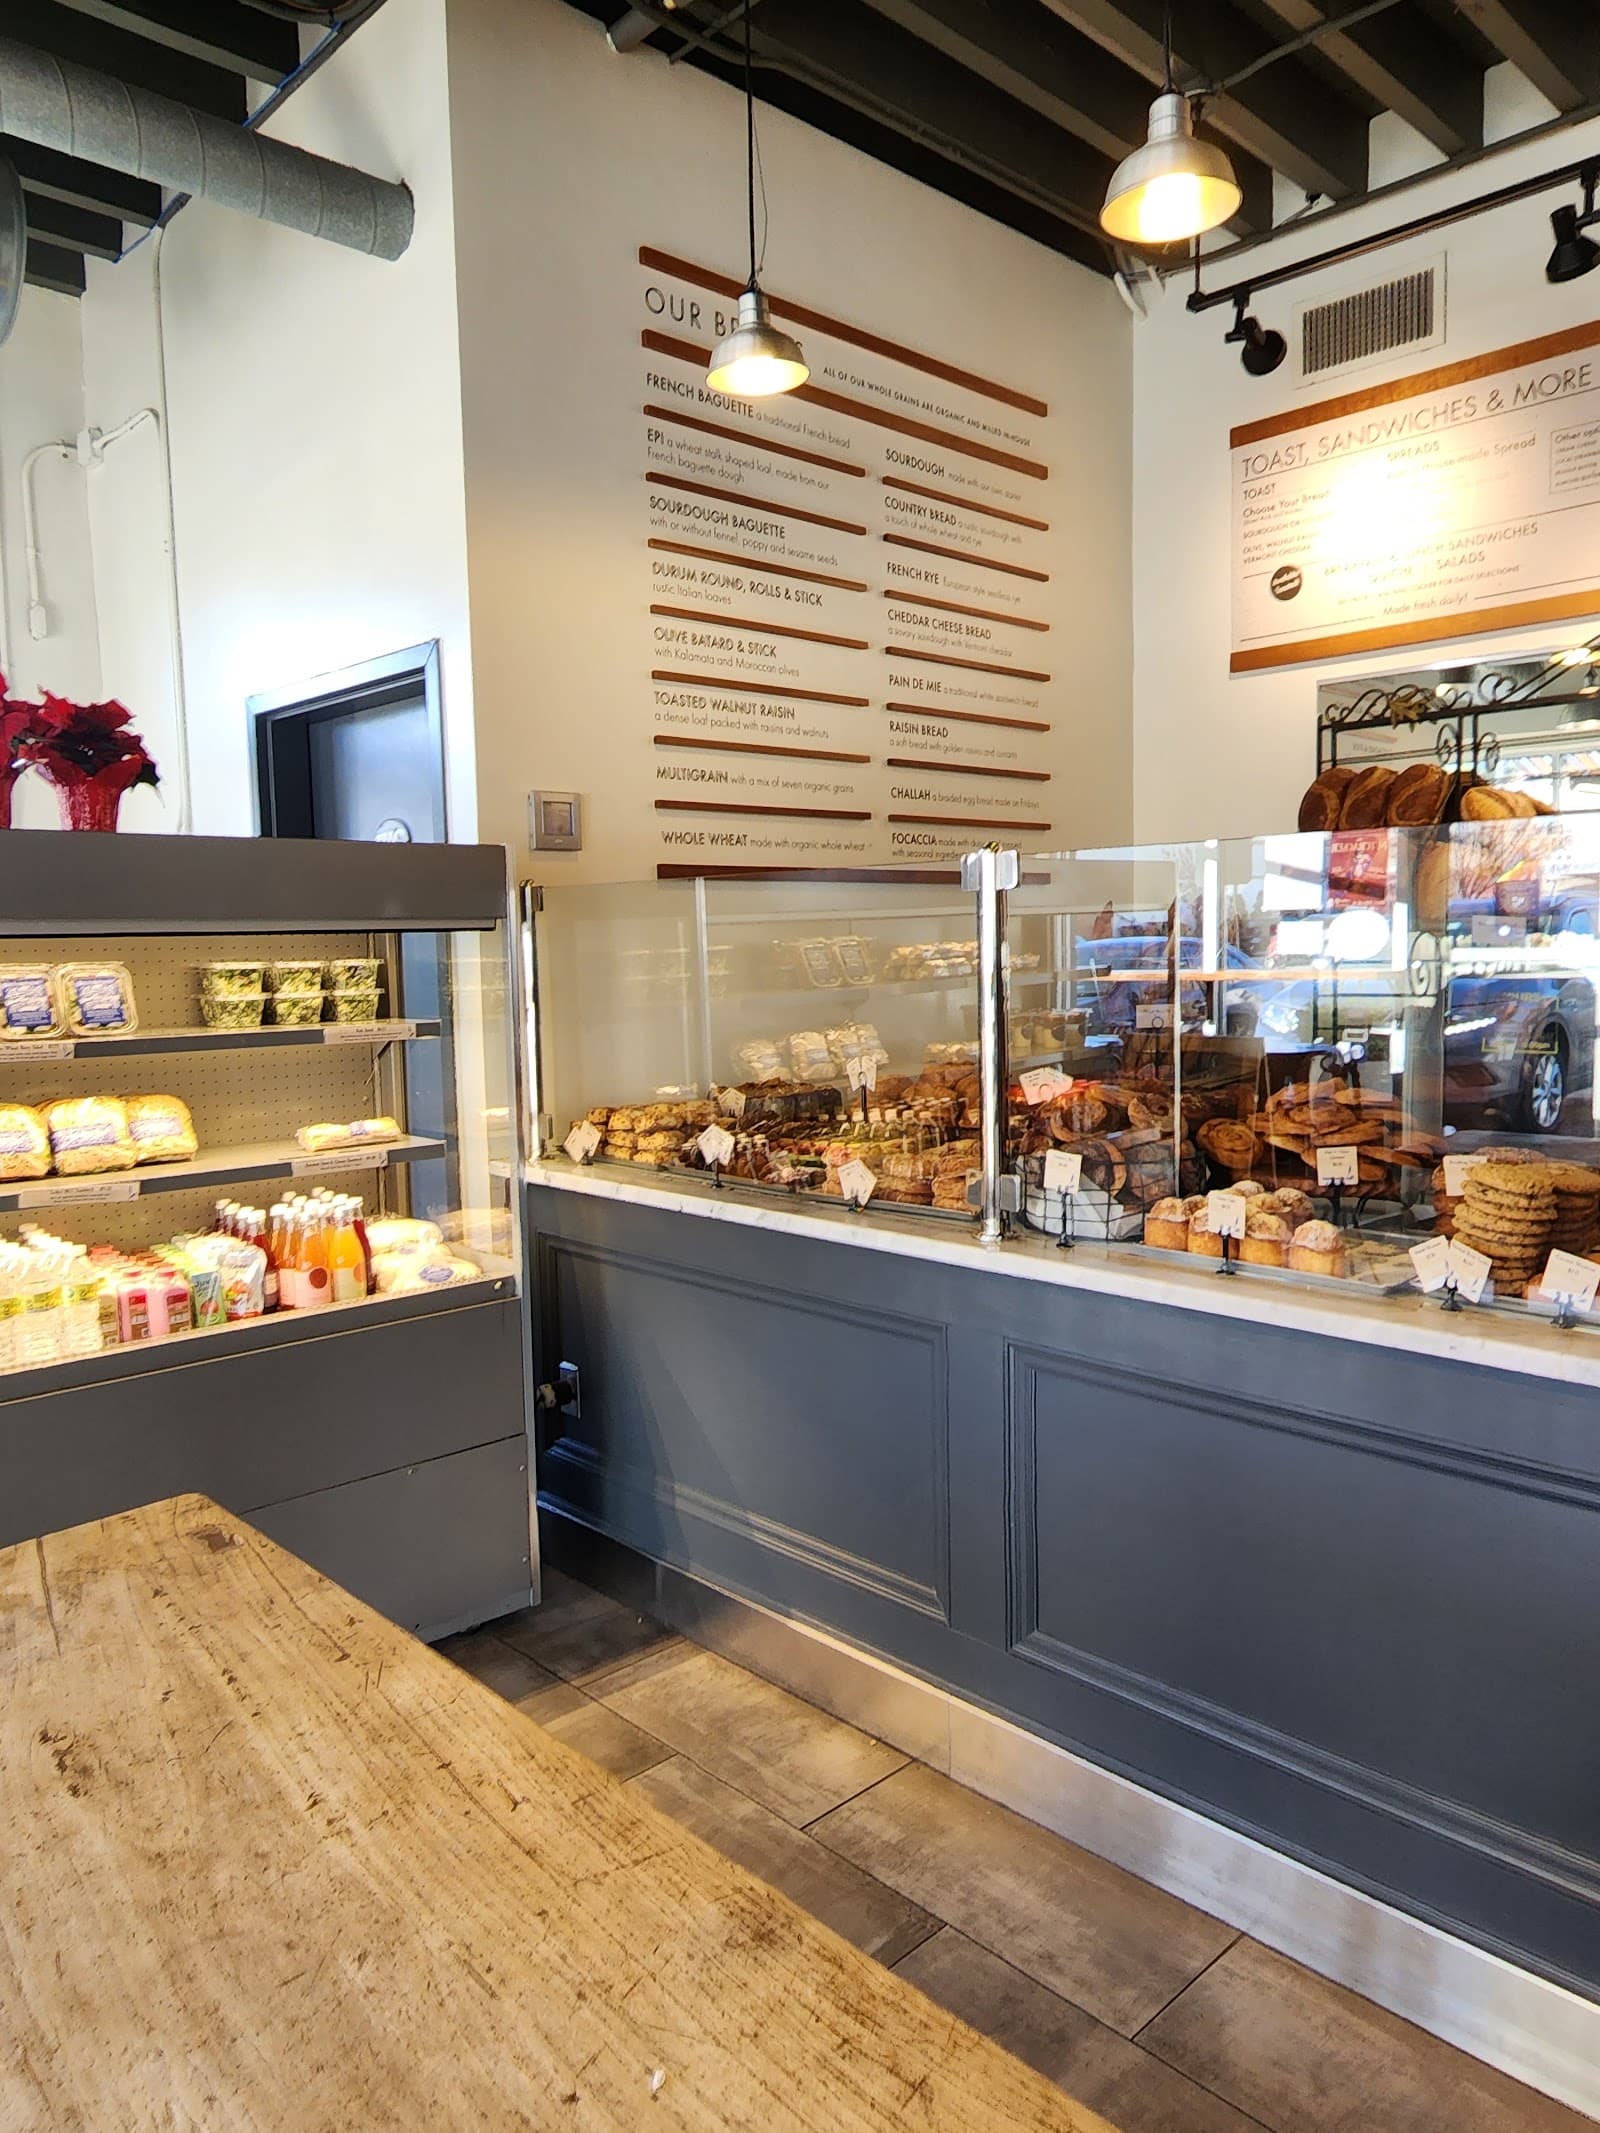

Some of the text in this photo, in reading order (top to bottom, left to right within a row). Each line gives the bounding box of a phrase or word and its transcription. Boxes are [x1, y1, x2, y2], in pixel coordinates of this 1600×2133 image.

[644, 287, 701, 330] OUR
[646, 372, 694, 400] FRENCH
[698, 388, 754, 418] BAGUETTE
[763, 412, 801, 432] traditional
[803, 423, 825, 440] French
[828, 434, 850, 448] bread
[823, 366, 835, 378] ALL
[838, 371, 848, 381] OF
[850, 375, 865, 388] OUR
[867, 382, 892, 398] WHOLE
[894, 391, 919, 407] GRAINS
[921, 401, 933, 412] ARE
[935, 406, 965, 424] ORGANIC
[967, 418, 981, 428] AND
[1241, 362, 1592, 479] TOAST, SANDWICHES & MORE
[647, 428, 664, 444] EPI
[675, 440, 702, 455] wheat
[704, 449, 721, 460] stalk
[725, 453, 755, 469] shaped
[775, 468, 796, 482] made
[799, 473, 815, 485] from
[817, 480, 830, 489] our
[1494, 434, 1536, 457] Spread
[648, 446, 745, 484] French baguette dough
[885, 448, 945, 478] SOURDOUGH
[1242, 482, 1276, 500] TOAST
[649, 495, 785, 538] SOURDOUGH BAGUETTE
[884, 495, 928, 519] COUNTRY
[930, 508, 957, 526] BREAD
[1242, 504, 1276, 518] Choose
[1279, 498, 1299, 509] Your
[650, 516, 668, 528] with
[682, 523, 711, 537] without
[742, 538, 769, 552] poppy
[770, 543, 785, 554] and
[788, 547, 815, 561] sesame
[817, 552, 839, 566] seeds
[1449, 522, 1538, 550] SANDWICHES
[887, 561, 922, 580] FRENCH
[924, 570, 940, 585] RYE
[1437, 551, 1486, 570] SALADS
[652, 561, 823, 607] DURUM ROUND, ROLLS & STICK
[653, 584, 732, 605] rustic Italian loaves
[1384, 603, 1410, 616] Made
[887, 609, 992, 640] CHEDDAR CHEESE BREAD
[654, 626, 777, 659] OLIVE BATARD & STICK
[654, 646, 799, 677] with Kalamata and Moroccan olives
[889, 674, 910, 689] PAIN
[912, 678, 924, 690] DE
[926, 680, 942, 693] MIE
[654, 690, 795, 720] TOASTED WALNUT RAISIN
[654, 711, 829, 739] a dense loaf packed with raisins and walnuts
[889, 720, 949, 738] RAISIN BREAD
[896, 738, 907, 748] soft
[908, 739, 928, 750] bread
[930, 741, 941, 751] with
[656, 765, 854, 795] MULTIGRAIN with a mix of seven organic grains
[890, 786, 931, 801] CHALLAH
[938, 792, 962, 803] braided
[661, 830, 865, 851] WHOLE WHEAT made with organic whole wheat
[892, 832, 937, 846] FOCACCIA
[938, 837, 956, 847] made
[957, 837, 971, 847] with
[892, 848, 933, 858] with seasonal
